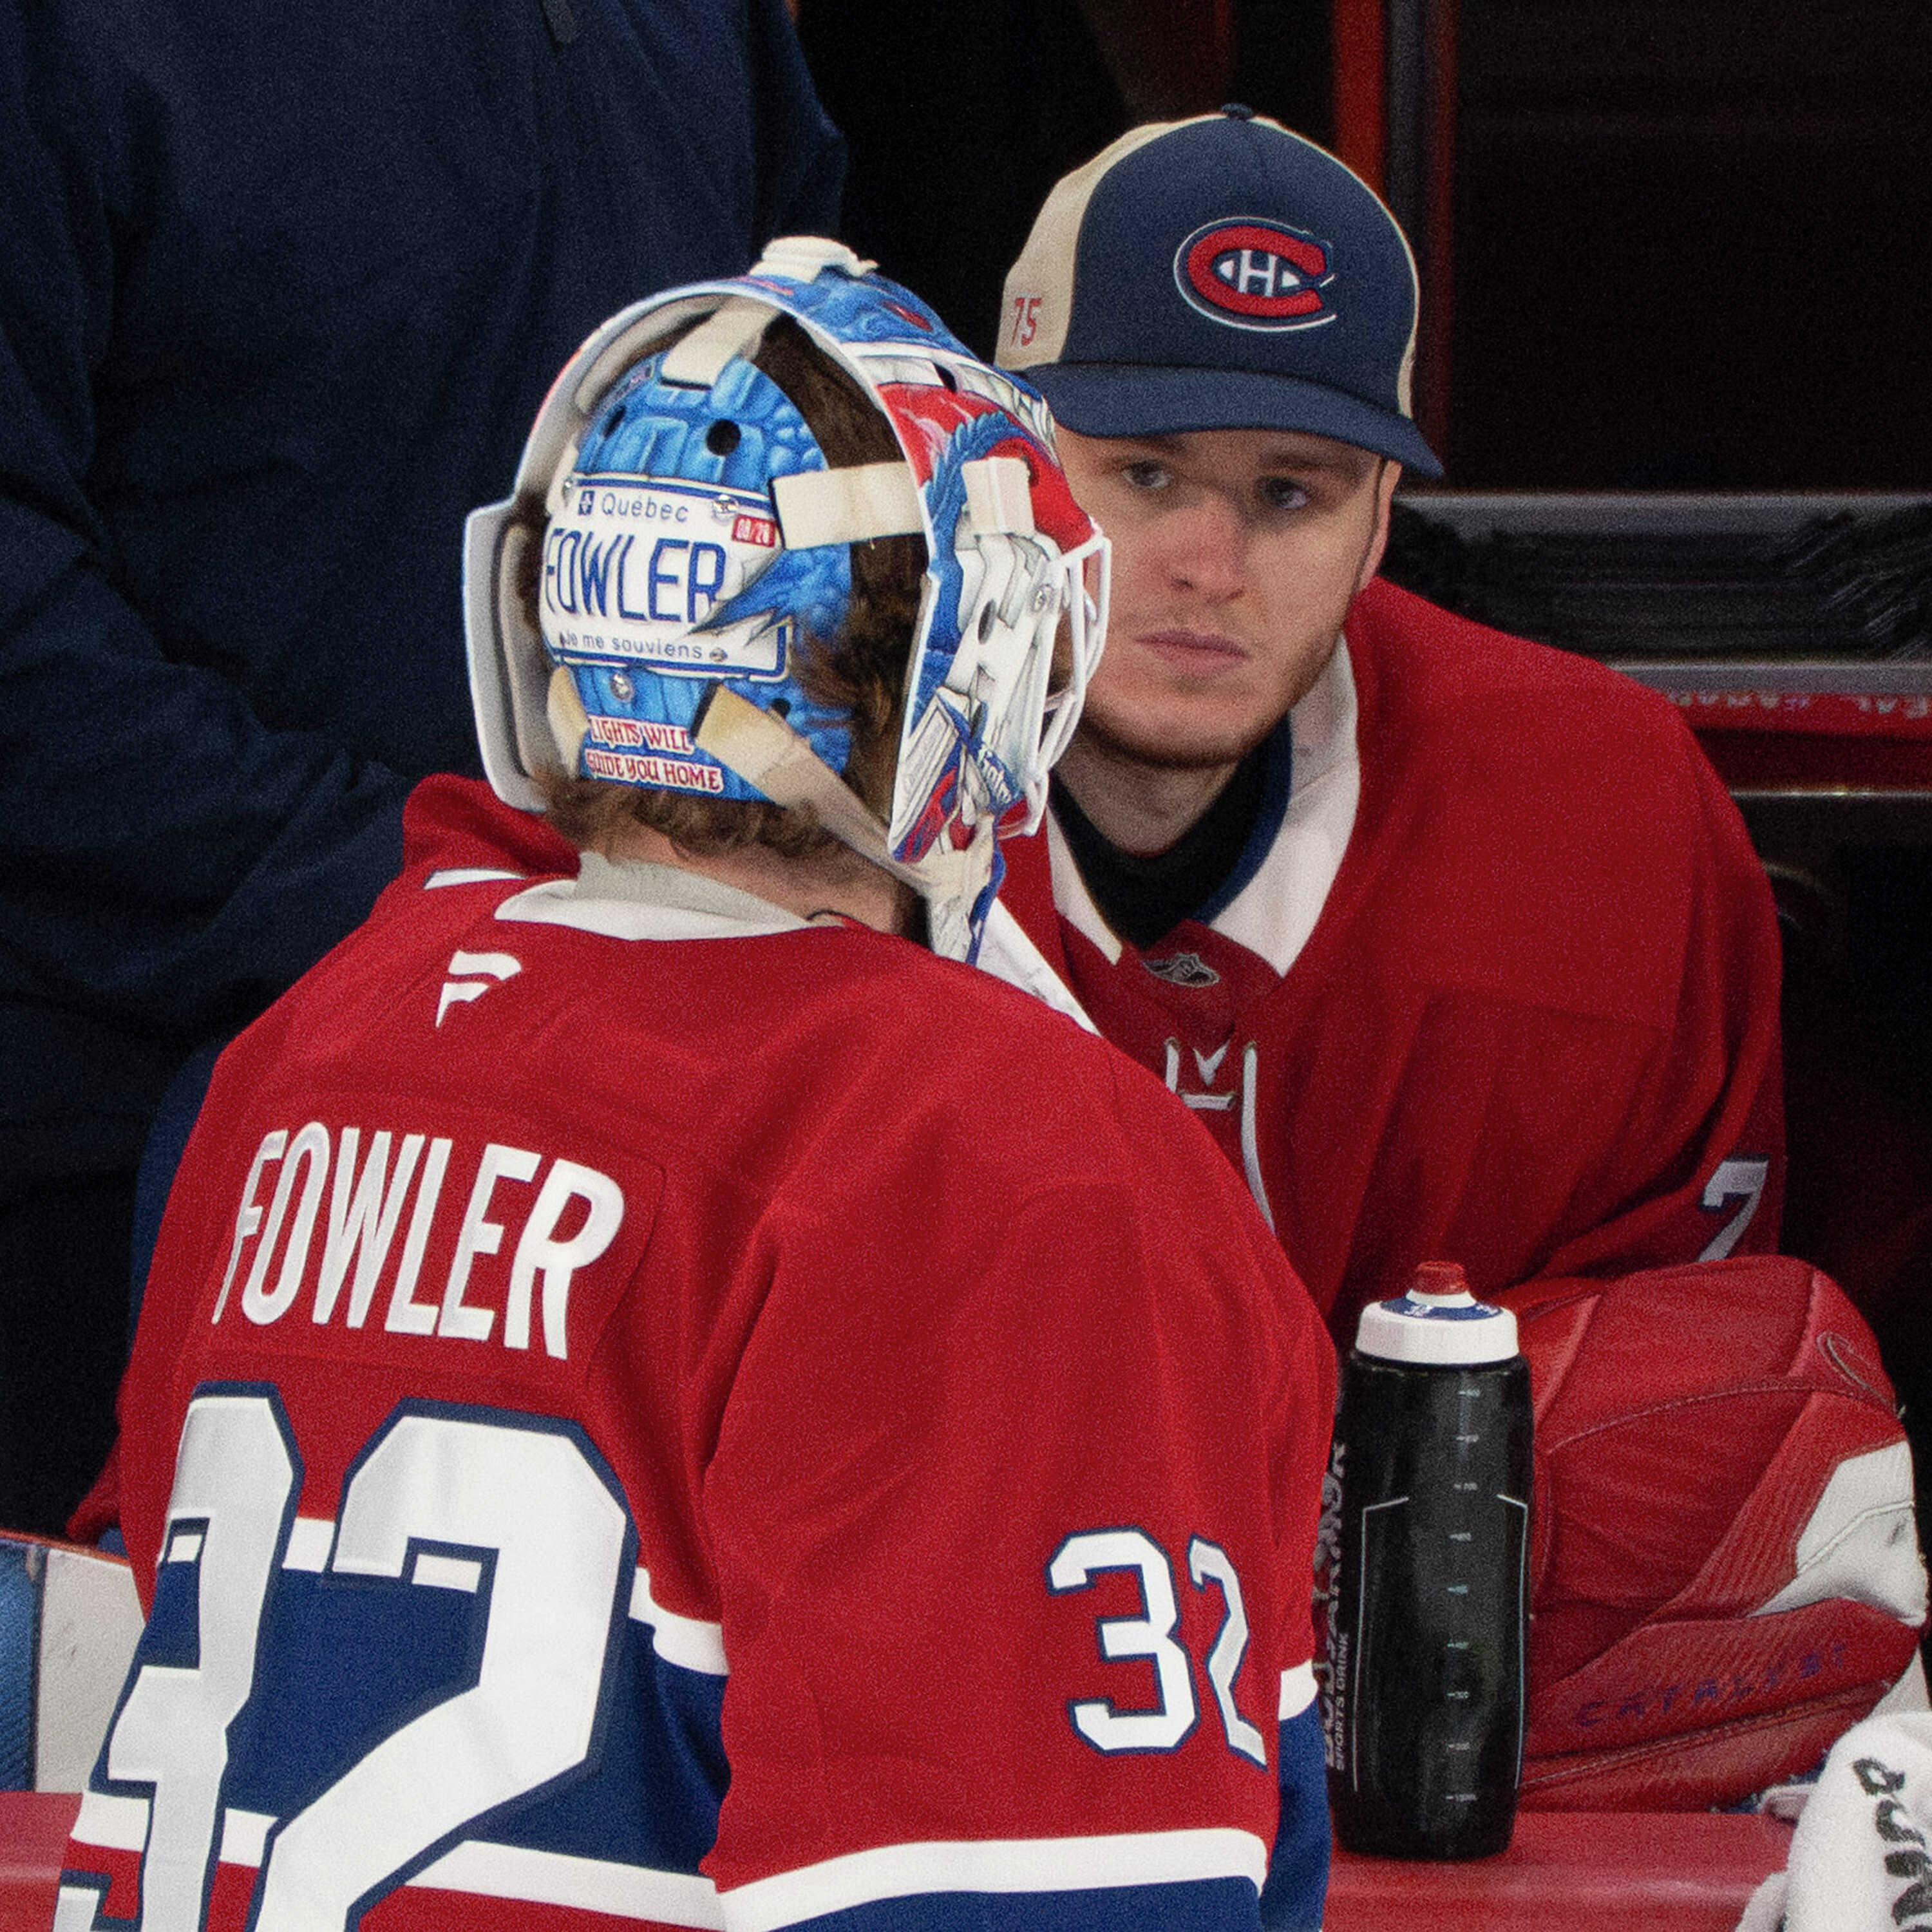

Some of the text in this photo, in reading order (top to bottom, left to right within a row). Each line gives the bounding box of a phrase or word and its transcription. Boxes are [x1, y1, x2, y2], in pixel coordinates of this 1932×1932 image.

[1010, 296, 1043, 347] 75
[601, 493, 689, 523] Québec
[545, 527, 726, 623] FOWLER
[582, 634, 604, 650] me
[612, 638, 703, 659] souviens
[589, 717, 692, 752] LIGHTS WILL
[585, 752, 720, 791] GUIDE YOU HOME
[211, 1121, 625, 1361] FOWLER
[52, 1381, 640, 1932] 32
[1043, 1524, 1269, 1772] 32
[1334, 1632, 1349, 1771] SPORTS DRINK
